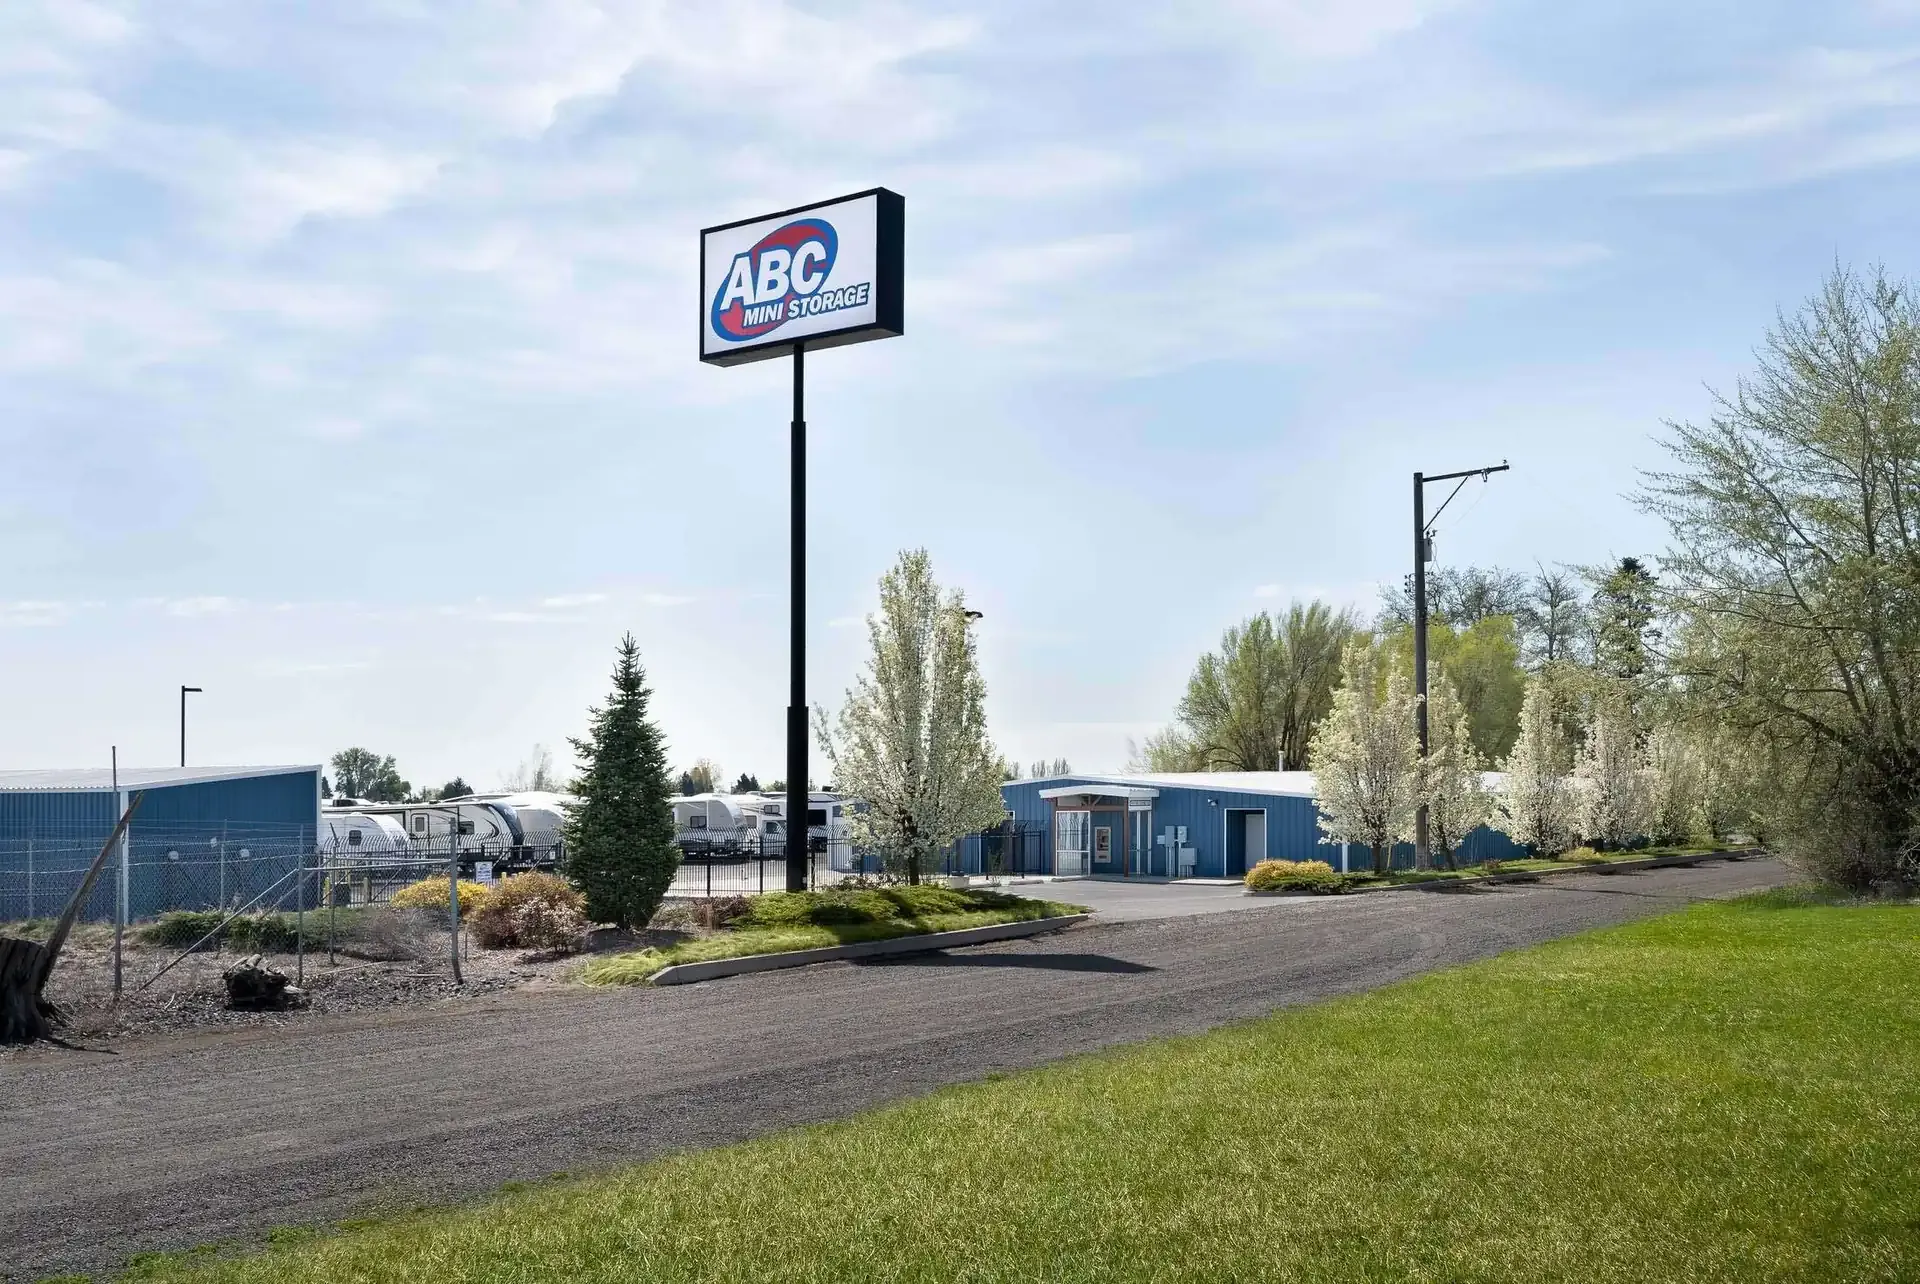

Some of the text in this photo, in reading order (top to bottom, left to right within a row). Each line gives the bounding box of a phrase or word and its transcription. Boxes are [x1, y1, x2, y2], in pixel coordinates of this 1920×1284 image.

[719, 240, 826, 310] ABC
[743, 284, 870, 327] MINI STORAGE
